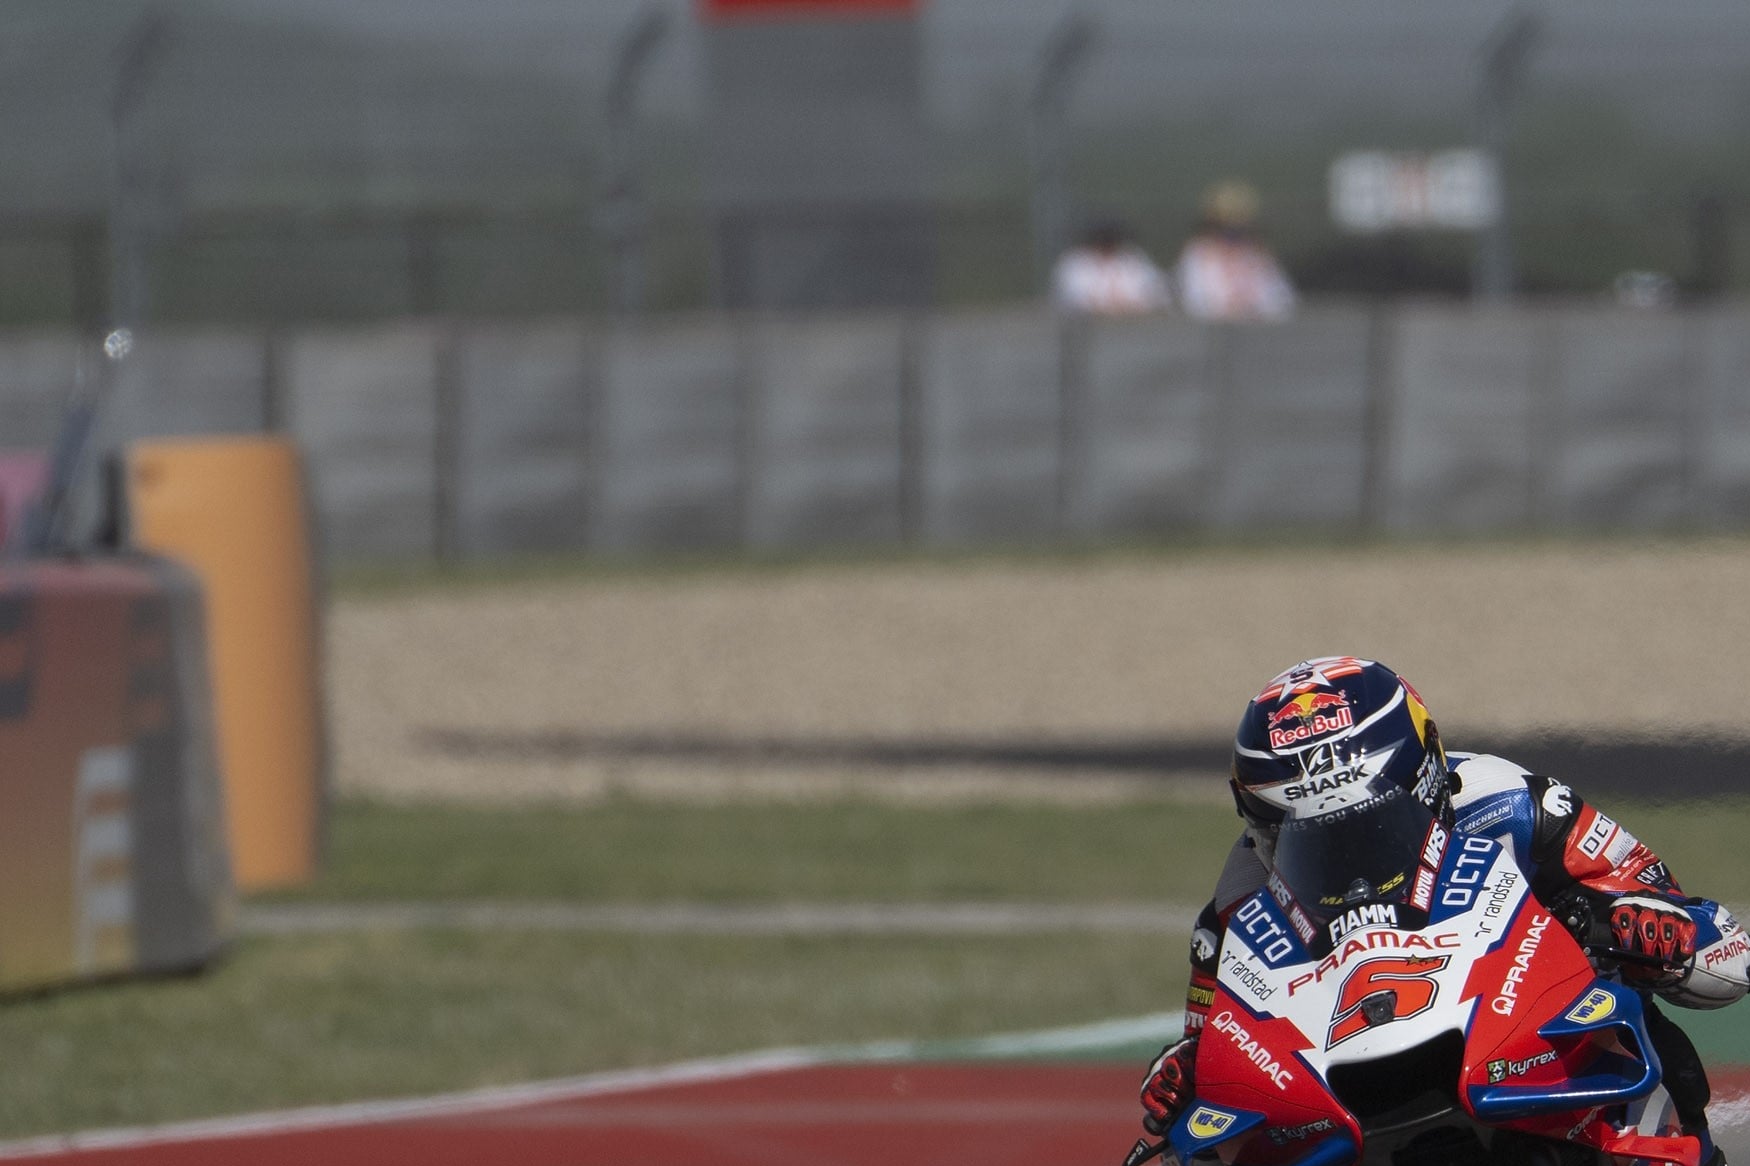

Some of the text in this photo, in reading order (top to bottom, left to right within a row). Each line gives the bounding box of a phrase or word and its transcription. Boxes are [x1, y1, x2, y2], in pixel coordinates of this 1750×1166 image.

[1269, 706, 1353, 748] Red Bull
[1284, 764, 1369, 801] SHARK
[1314, 810, 1347, 826] YOU
[1353, 784, 1403, 814] WINGS
[1412, 869, 1435, 910] MOTUL
[1441, 837, 1494, 906] OCTO
[1483, 870, 1518, 918] randstad
[1236, 898, 1293, 962] OCTO
[1290, 906, 1317, 943] MOTUL
[1329, 904, 1398, 946] FIAMM
[1229, 957, 1278, 1001] randstad
[1287, 931, 1461, 997] PRAMAC
[1499, 915, 1552, 1006] PRAMAC
[1324, 954, 1452, 1052] 5
[1573, 993, 1607, 1018] WD-40
[1220, 1022, 1293, 1091] PRAMAC
[1507, 1050, 1558, 1077] kyrrex
[1281, 1118, 1333, 1139] kyrrex
